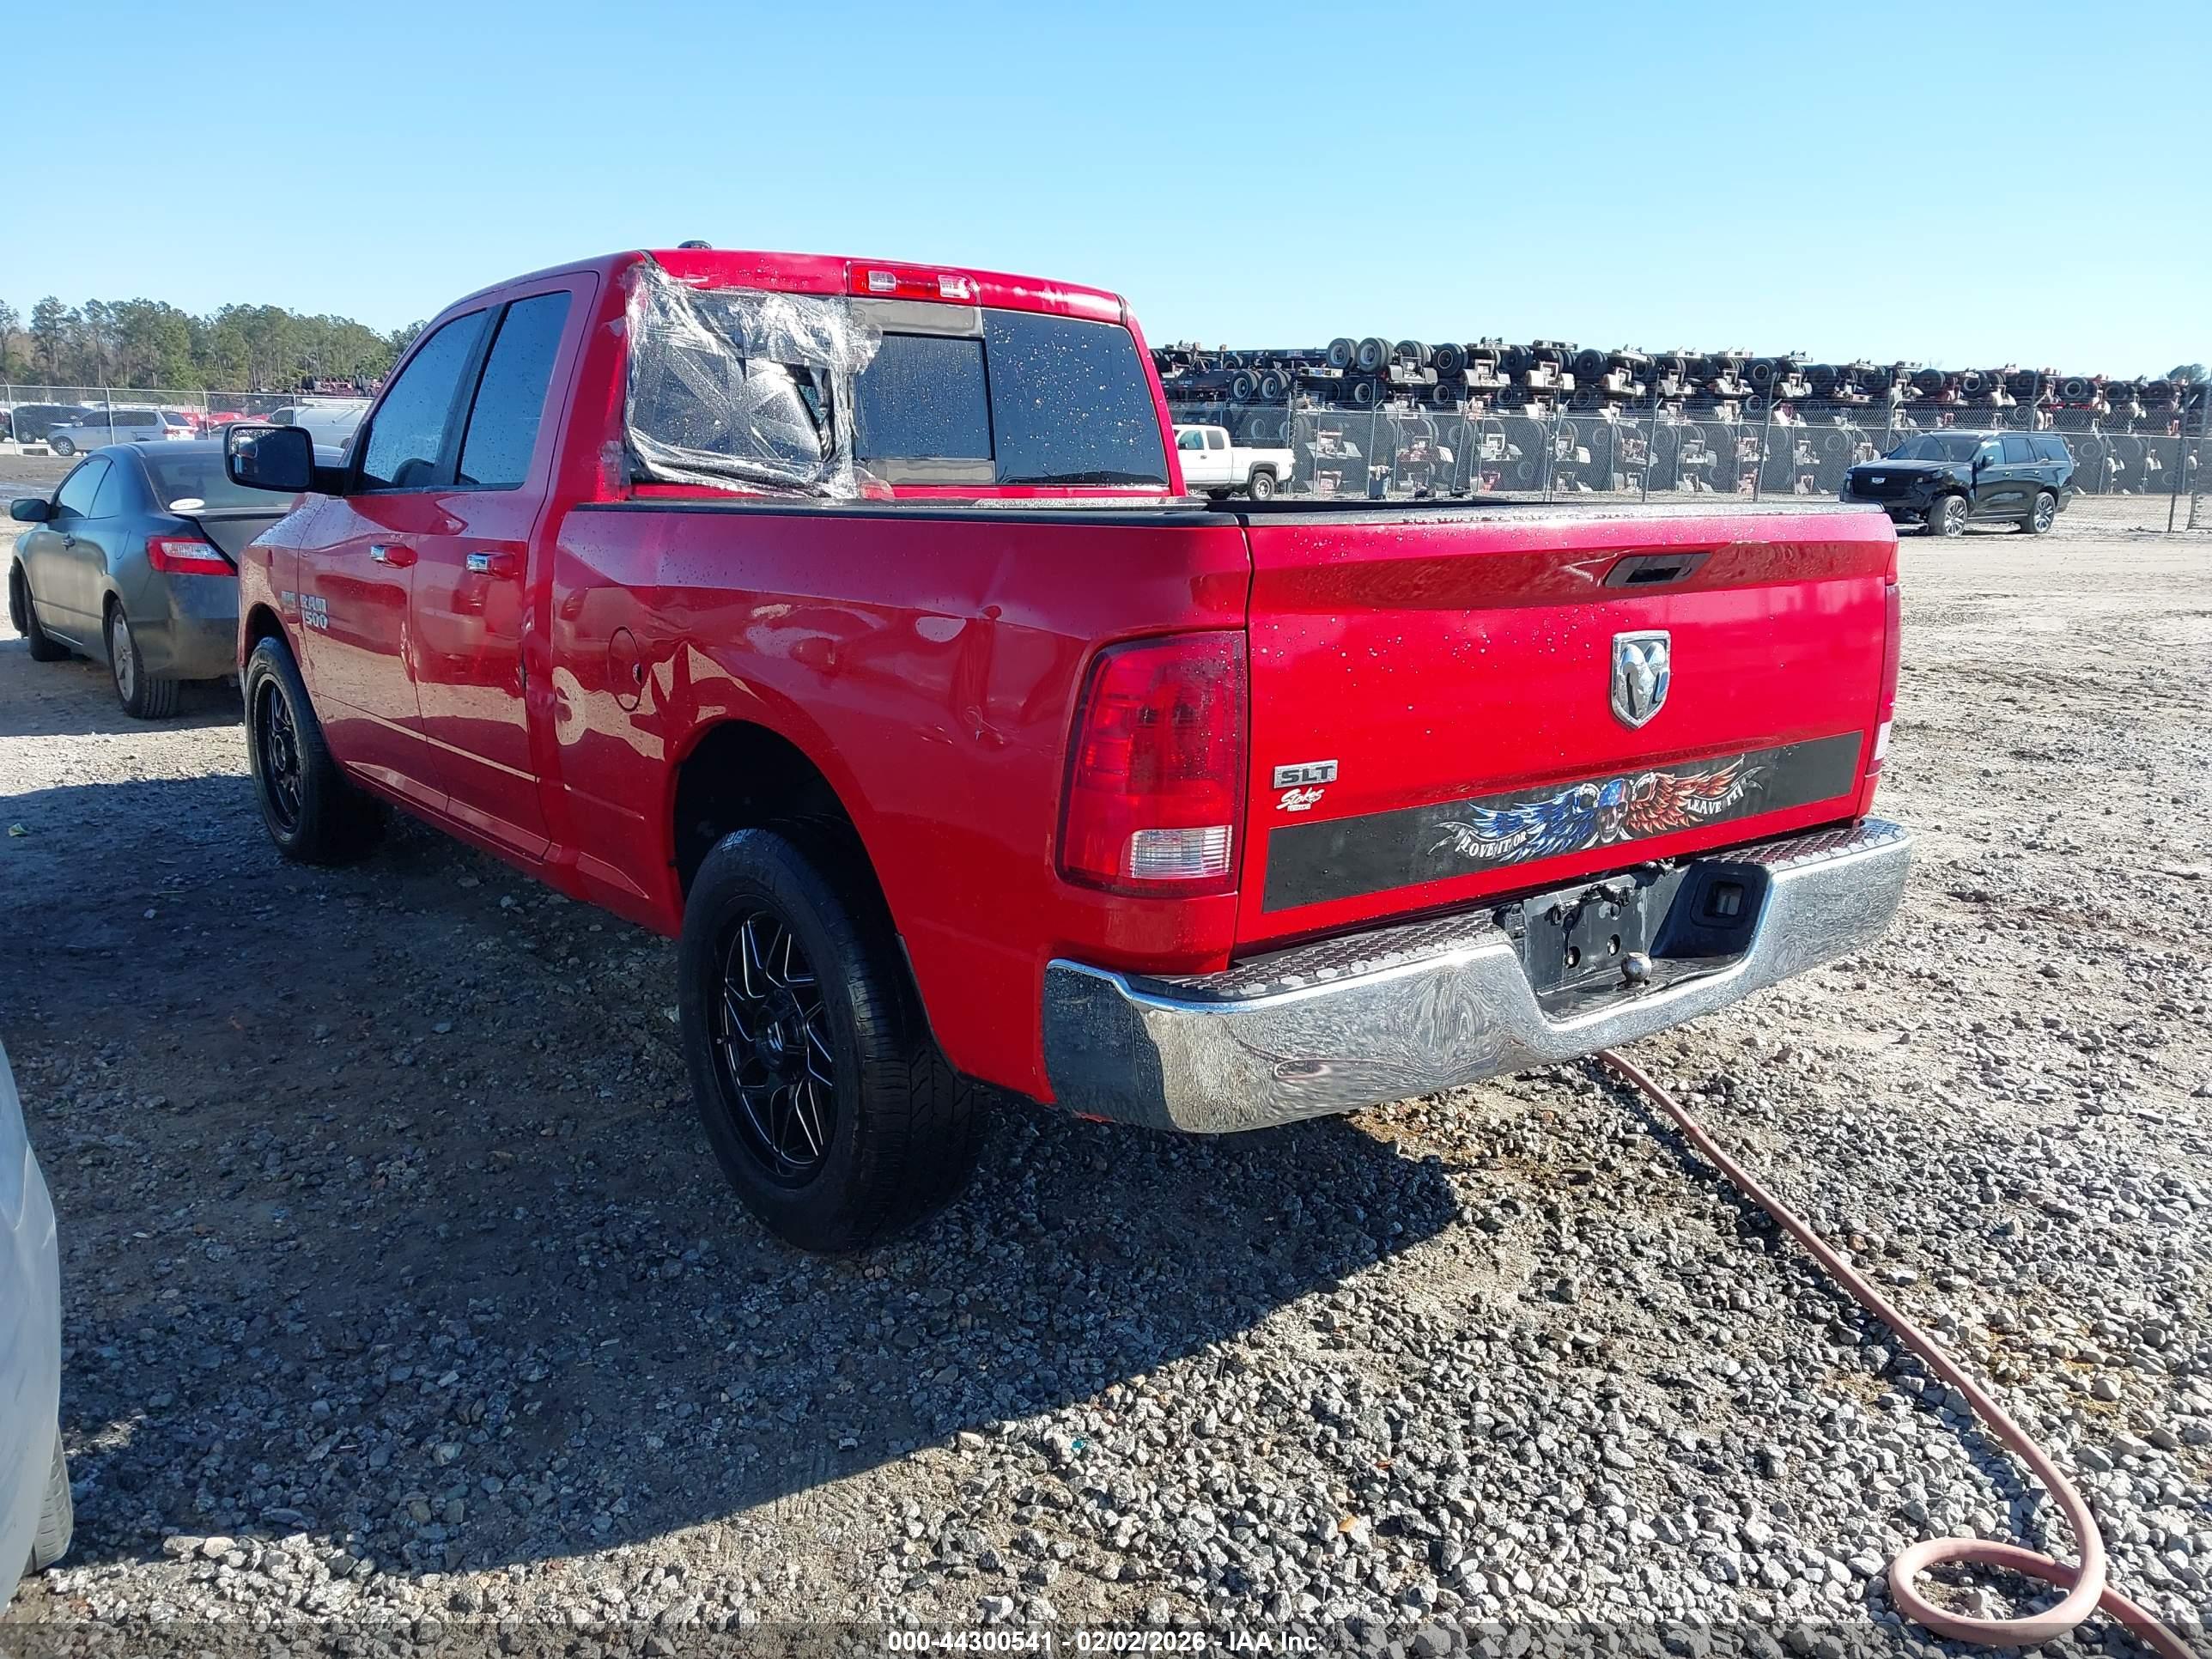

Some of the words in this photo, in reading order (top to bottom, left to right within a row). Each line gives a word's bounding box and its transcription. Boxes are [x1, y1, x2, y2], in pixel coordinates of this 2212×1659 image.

[300, 594, 326, 612] RAM
[301, 609, 328, 629] 1500
[1280, 765, 1334, 784] SLT
[1275, 787, 1325, 810] Stokes
[1686, 798, 1723, 815] LEAVE
[1458, 835, 1496, 858] LOVE
[1497, 838, 1512, 854] IT
[1513, 830, 1528, 847] OR
